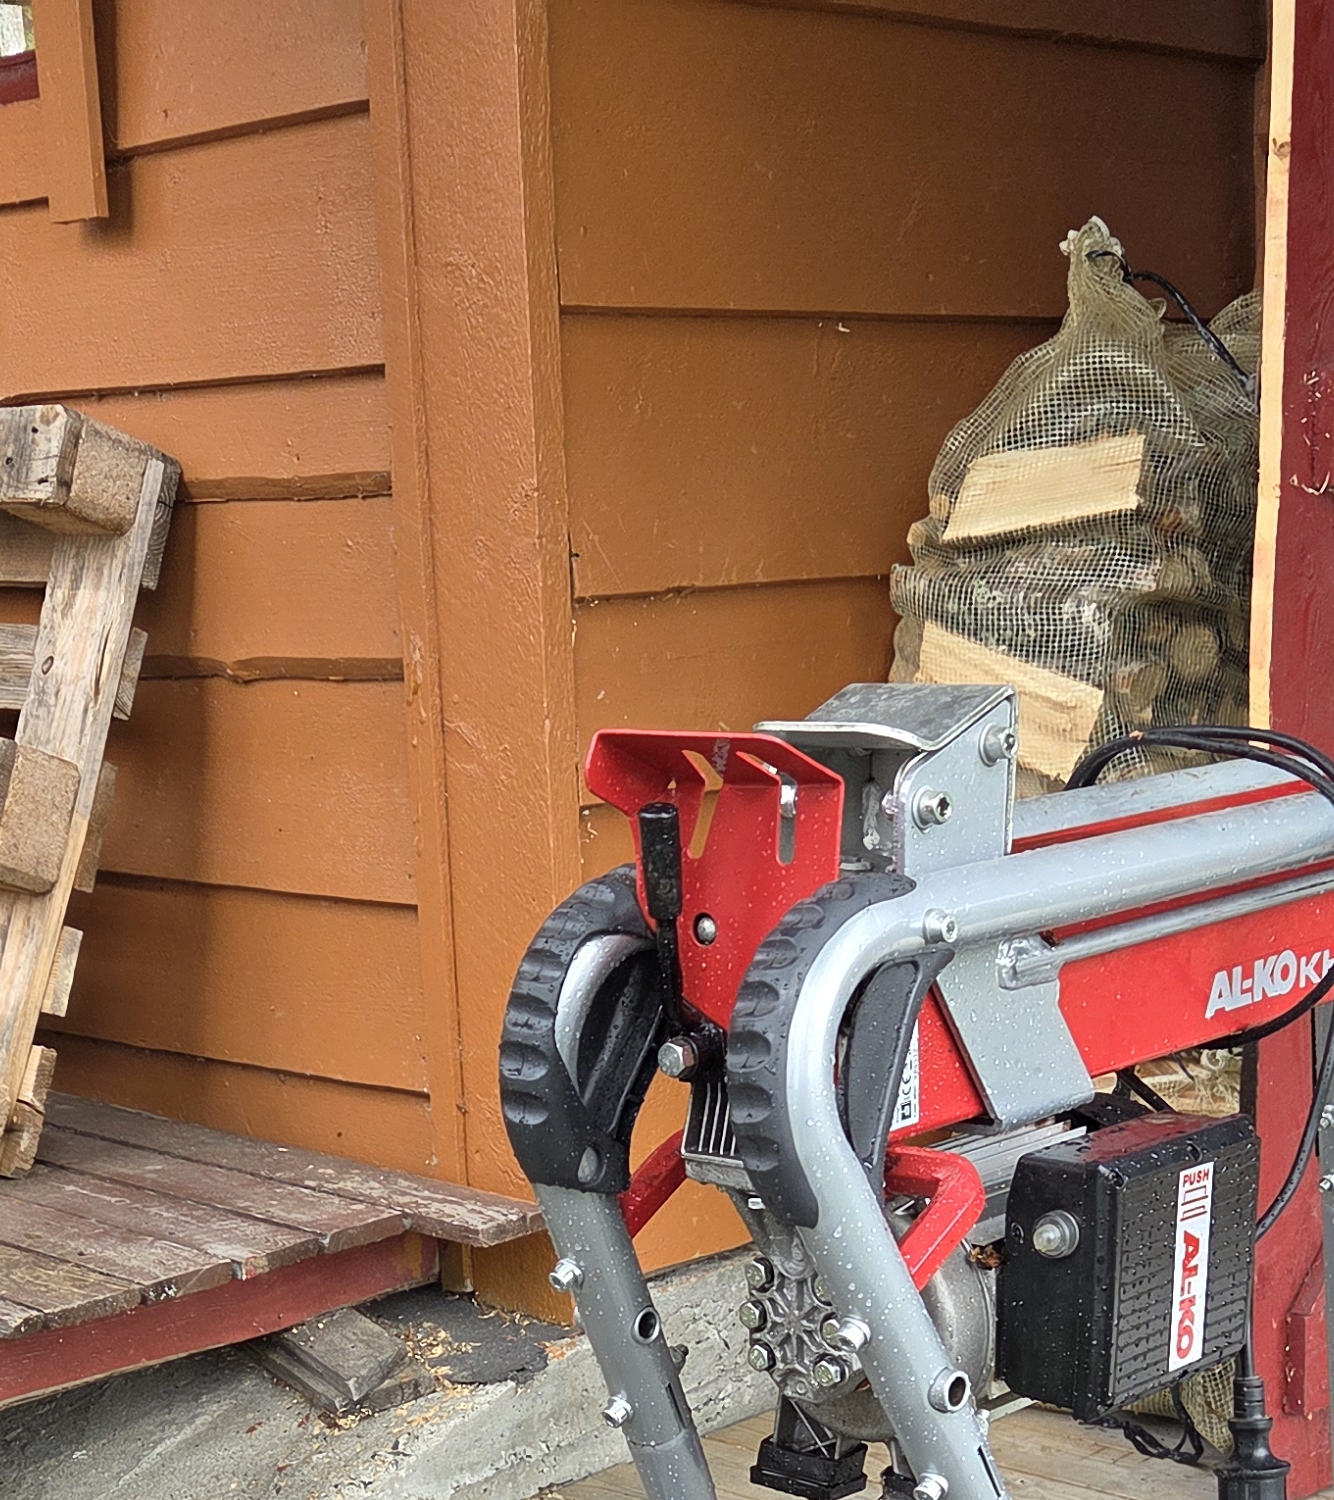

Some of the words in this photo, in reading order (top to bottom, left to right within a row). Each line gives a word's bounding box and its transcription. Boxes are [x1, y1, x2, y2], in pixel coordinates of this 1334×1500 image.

[1205, 950, 1297, 1018] AL-KO
[1182, 1168, 1210, 1188] PUSH
[1176, 1230, 1200, 1359] AL-KO
